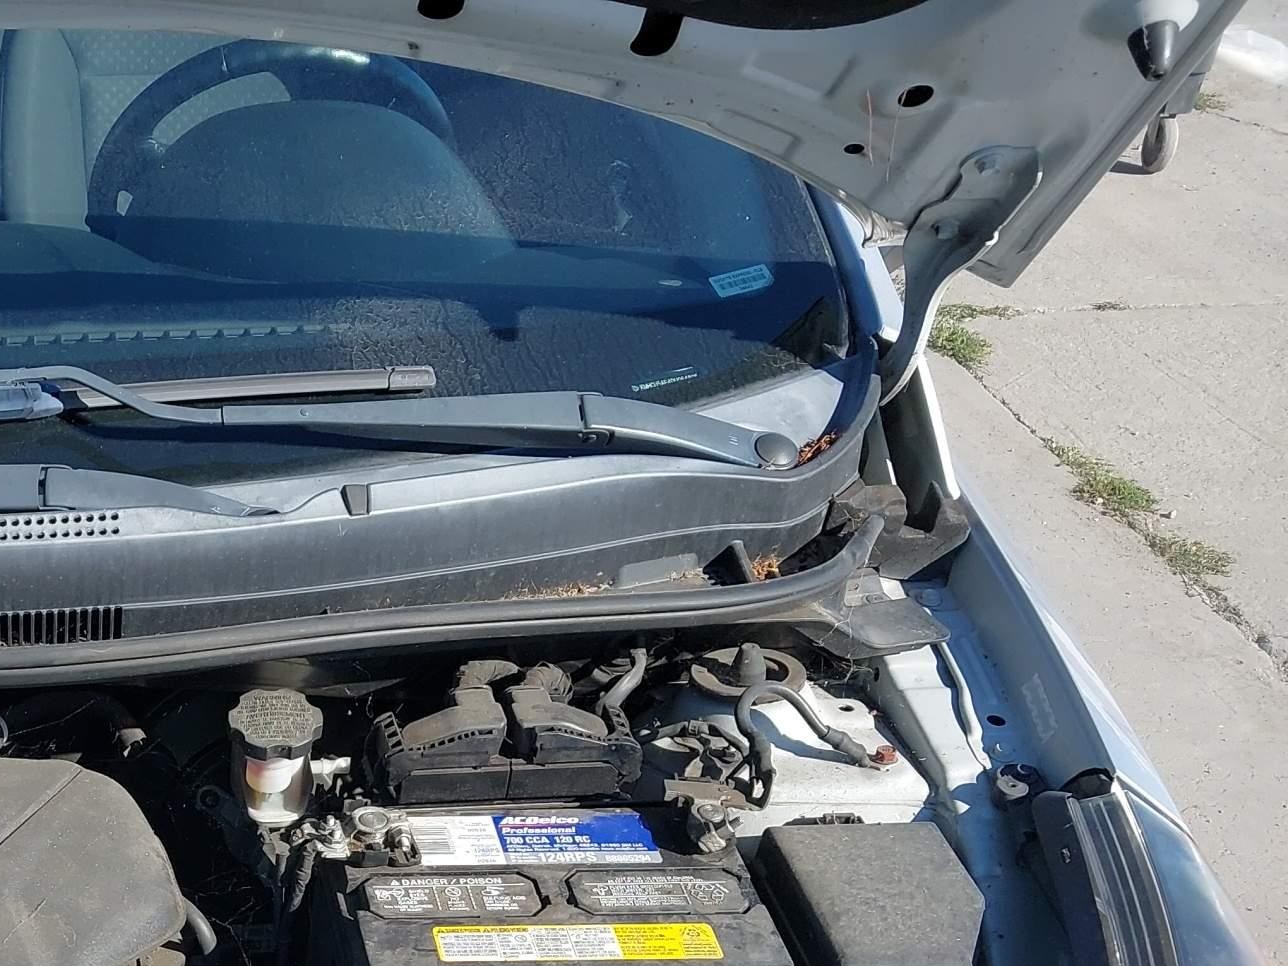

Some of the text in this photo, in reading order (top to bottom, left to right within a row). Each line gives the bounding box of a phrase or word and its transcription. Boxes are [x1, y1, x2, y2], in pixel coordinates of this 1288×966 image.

[499, 816, 579, 825] ACDelco
[501, 826, 576, 834] Professional
[503, 836, 523, 844] 700
[525, 836, 550, 844] CCA
[554, 836, 573, 844] 120
[574, 835, 591, 843] RC
[539, 851, 598, 863] 124RPS
[401, 877, 448, 886] DANGER
[459, 876, 503, 885] POISON
